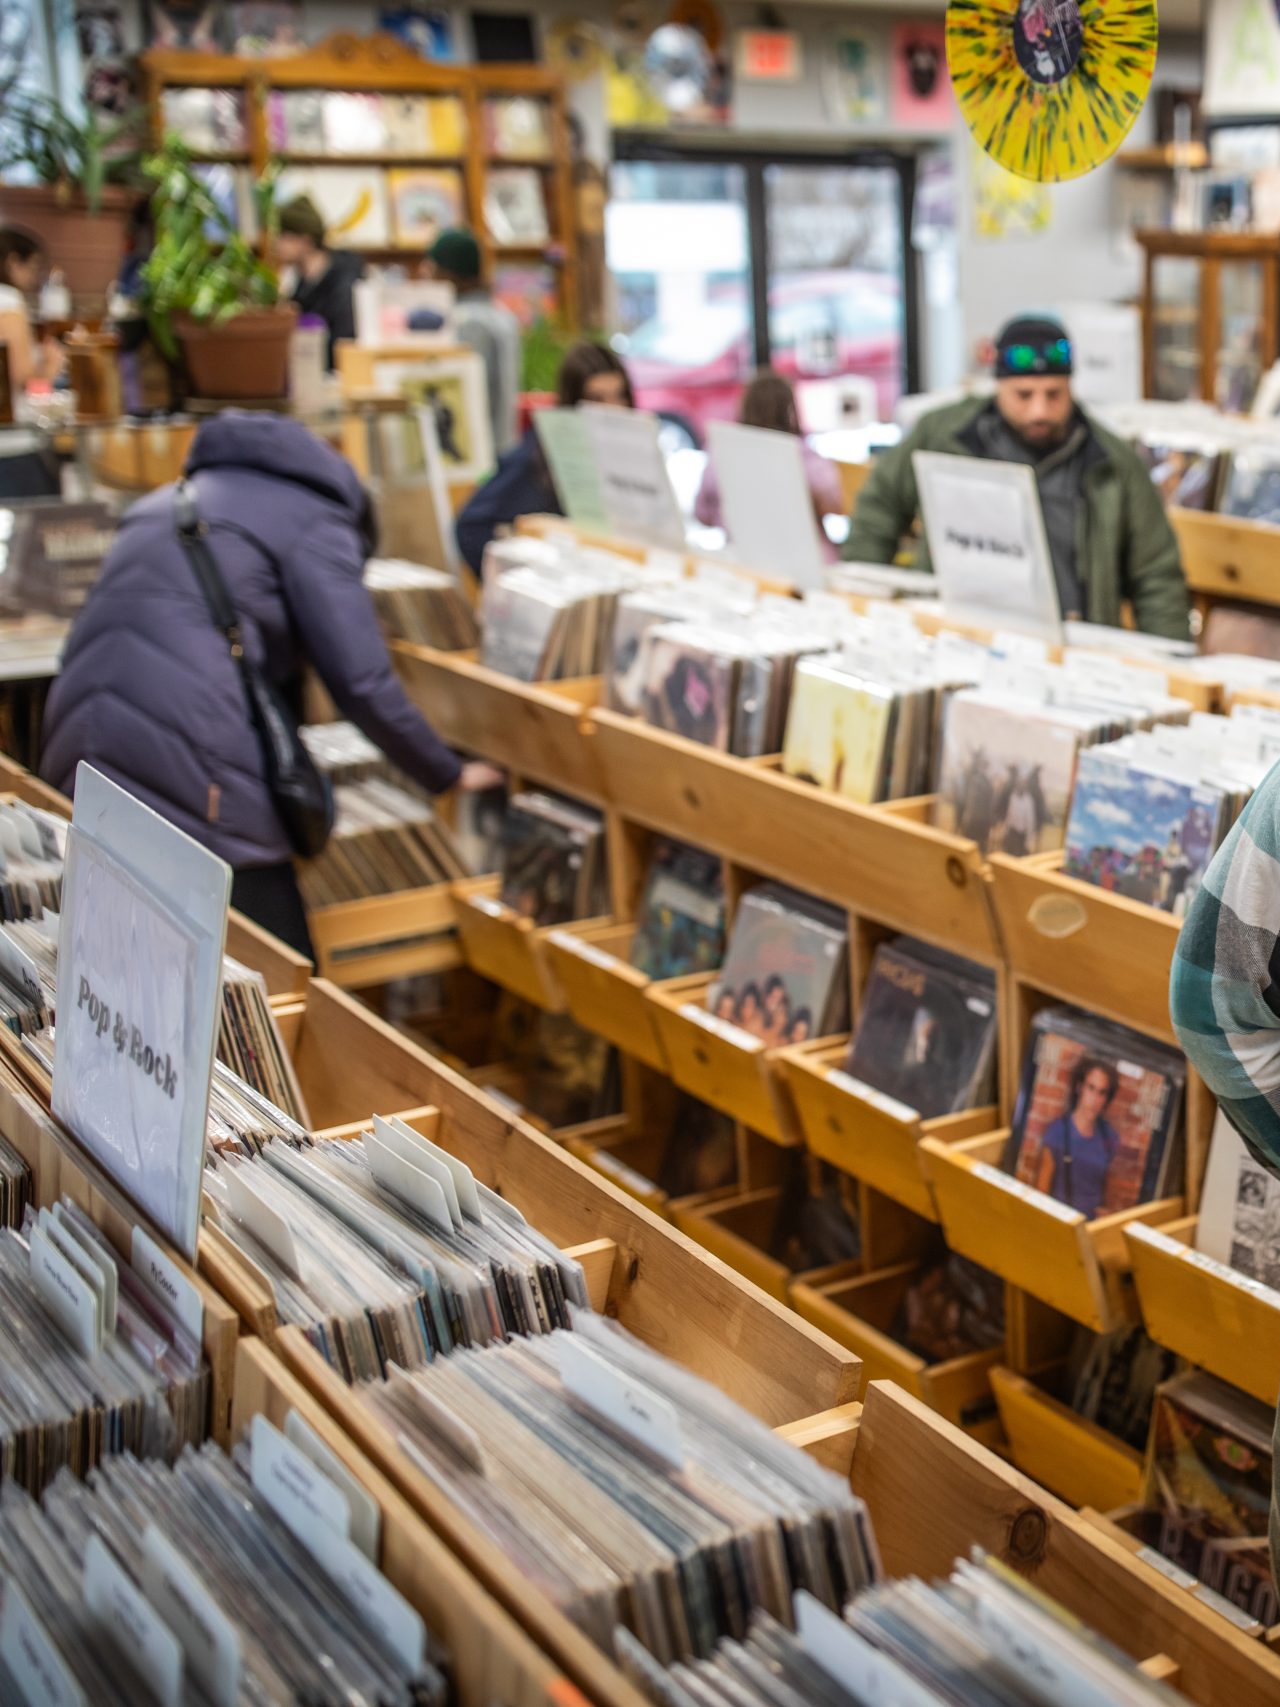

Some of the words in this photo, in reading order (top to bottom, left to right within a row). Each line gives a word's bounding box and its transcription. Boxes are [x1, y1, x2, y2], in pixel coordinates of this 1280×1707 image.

[77, 974, 111, 1038] Pop
[113, 1011, 128, 1053] &
[129, 1023, 178, 1100] Rock
